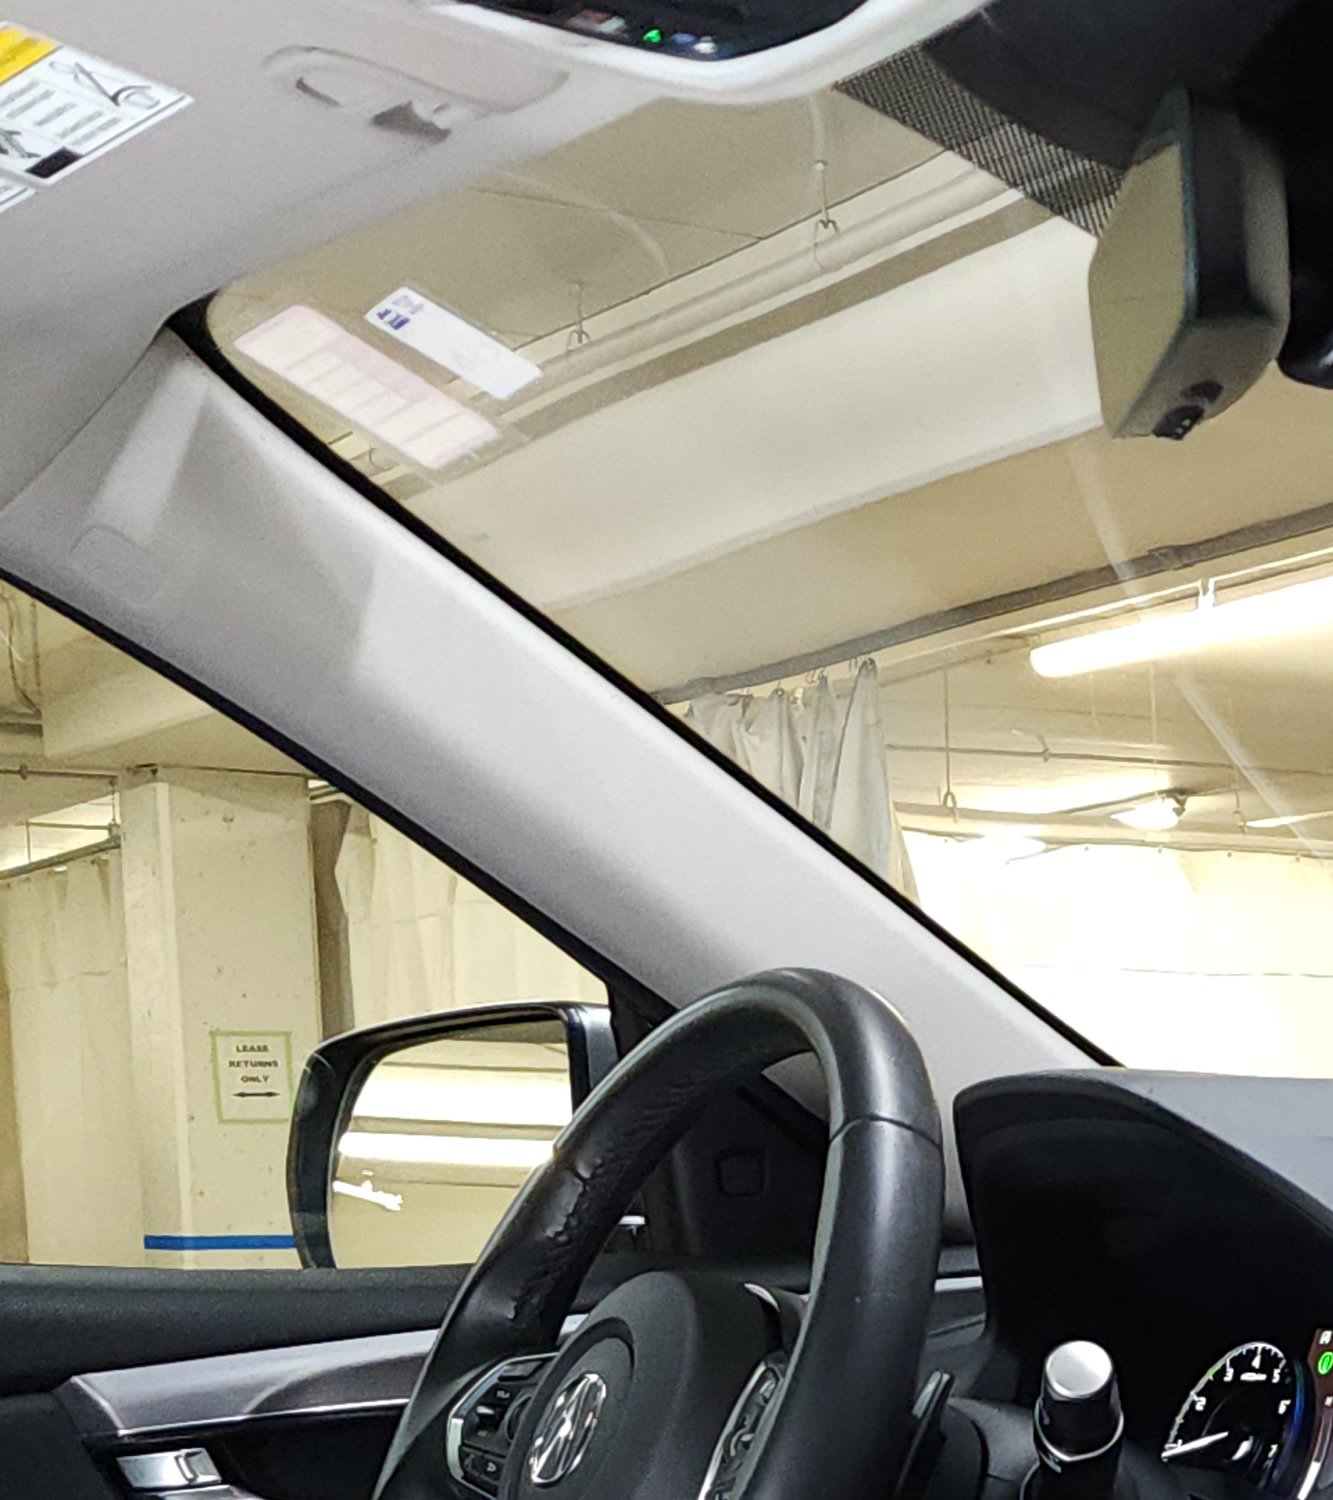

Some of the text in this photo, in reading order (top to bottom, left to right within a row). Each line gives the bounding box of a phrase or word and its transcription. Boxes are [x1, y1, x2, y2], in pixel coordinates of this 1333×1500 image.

[235, 1044, 269, 1053] LEASE
[228, 1060, 279, 1068] RETURNS
[240, 1075, 270, 1083] ONLY
[1223, 1367, 1234, 1382] 3
[1271, 1368, 1281, 1384] 5
[1195, 1396, 1207, 1411] 2
